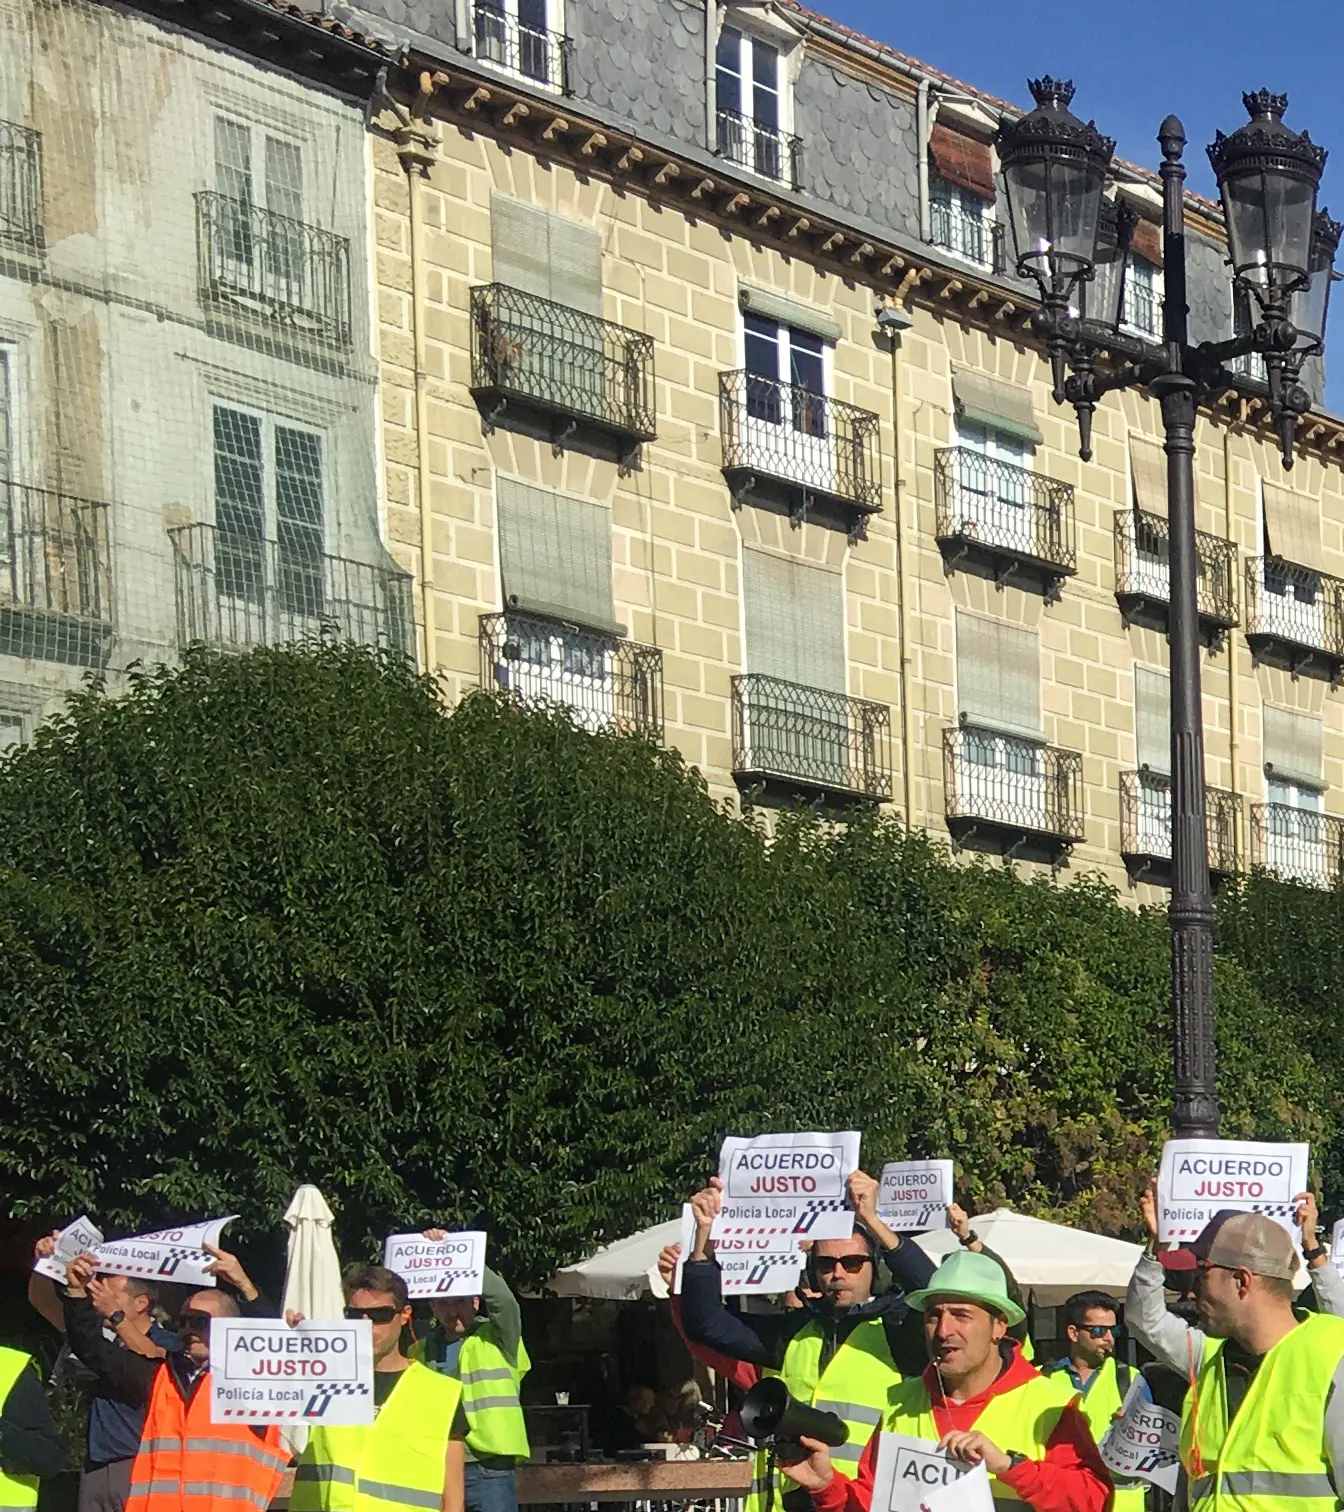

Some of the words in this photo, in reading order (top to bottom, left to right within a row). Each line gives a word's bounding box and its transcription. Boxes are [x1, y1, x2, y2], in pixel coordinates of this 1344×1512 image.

[736, 1153, 835, 1170] ACUERDO
[1179, 1159, 1283, 1177] ACUERDO
[750, 1176, 817, 1193] JUSTO
[883, 1174, 937, 1187] ACUERDO
[891, 1189, 928, 1202] JUSTO
[1194, 1181, 1264, 1198] JUSTO
[721, 1206, 762, 1219] Policía
[765, 1206, 797, 1219] Local
[1163, 1208, 1204, 1221] Policía
[131, 1247, 160, 1261] Local
[395, 1243, 468, 1257] ACUERDO
[404, 1256, 453, 1270] JUSTO
[721, 1260, 749, 1271] Local
[414, 1275, 437, 1284] Local
[234, 1336, 348, 1354] ACUERDO
[252, 1359, 327, 1376] JUSTO
[217, 1387, 264, 1401] Policía
[268, 1388, 304, 1401] Local
[1131, 1410, 1177, 1434] ERDO
